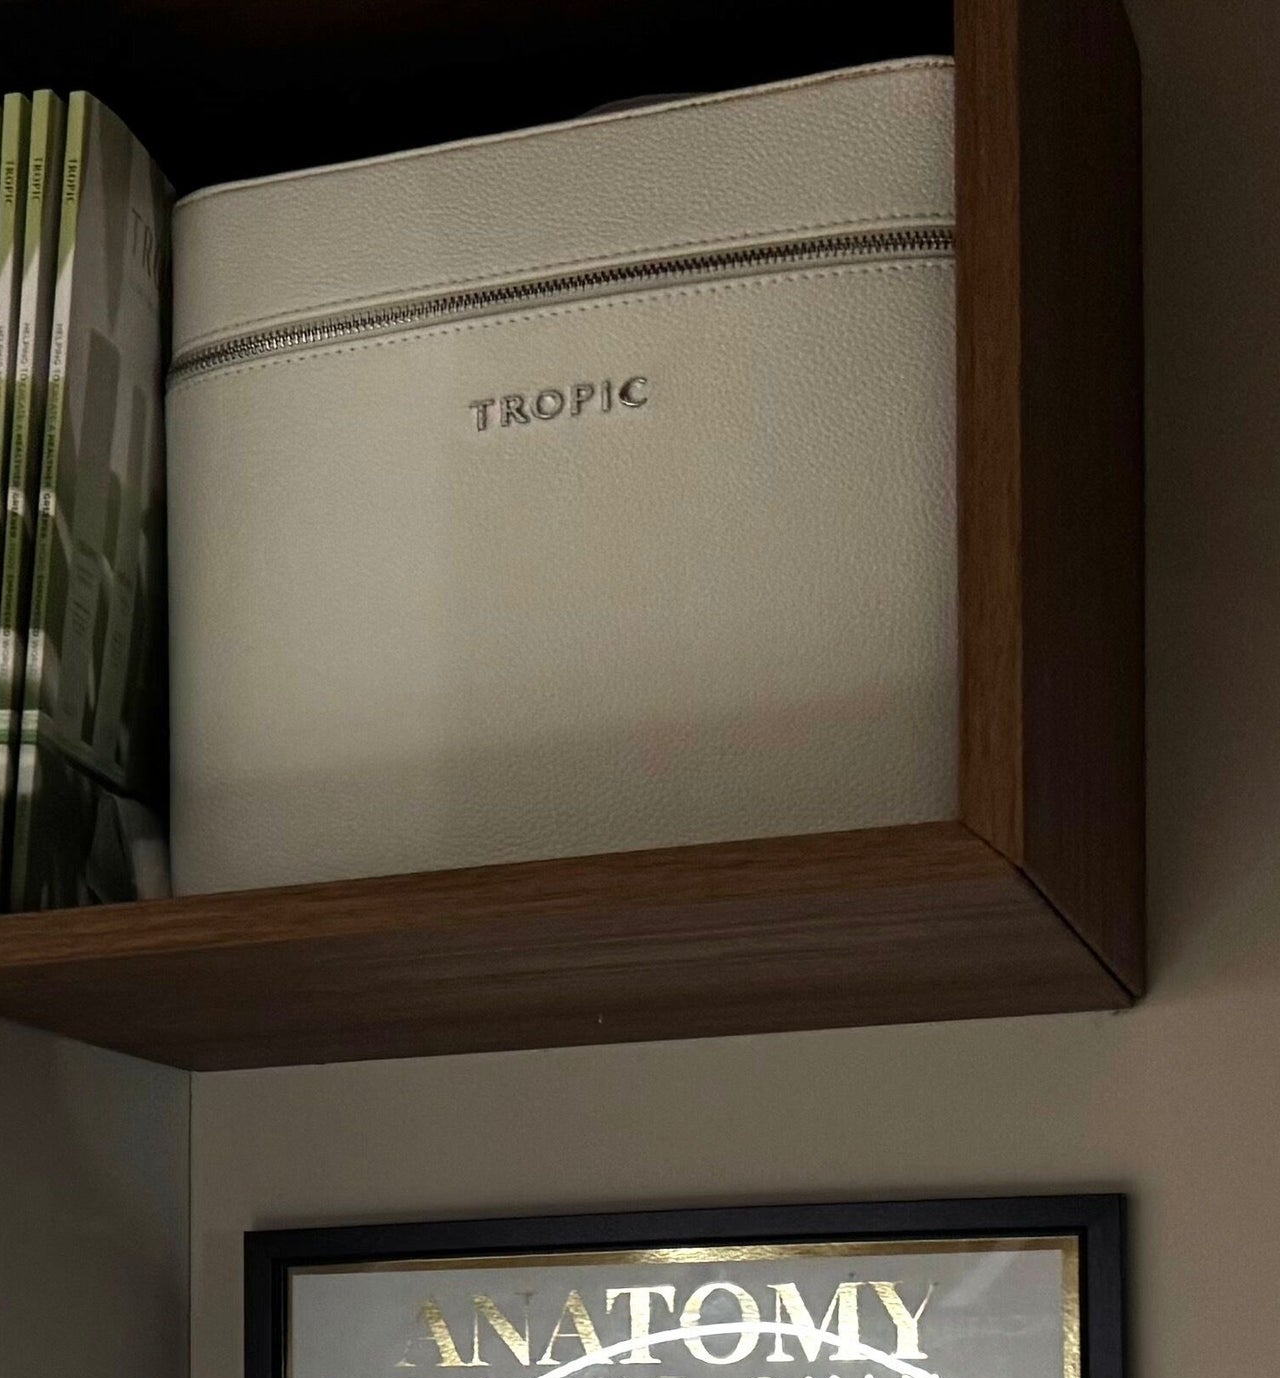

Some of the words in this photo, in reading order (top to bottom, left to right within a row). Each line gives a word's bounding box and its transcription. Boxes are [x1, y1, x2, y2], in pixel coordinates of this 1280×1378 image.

[4, 160, 14, 205] TROPIC
[31, 157, 42, 200] TROPIC
[65, 158, 78, 201] TROPIC
[20, 322, 31, 364] HELPING
[53, 323, 64, 365] HELPING
[468, 376, 648, 432] TROPIC
[395, 1281, 938, 1368] ANATOMY
